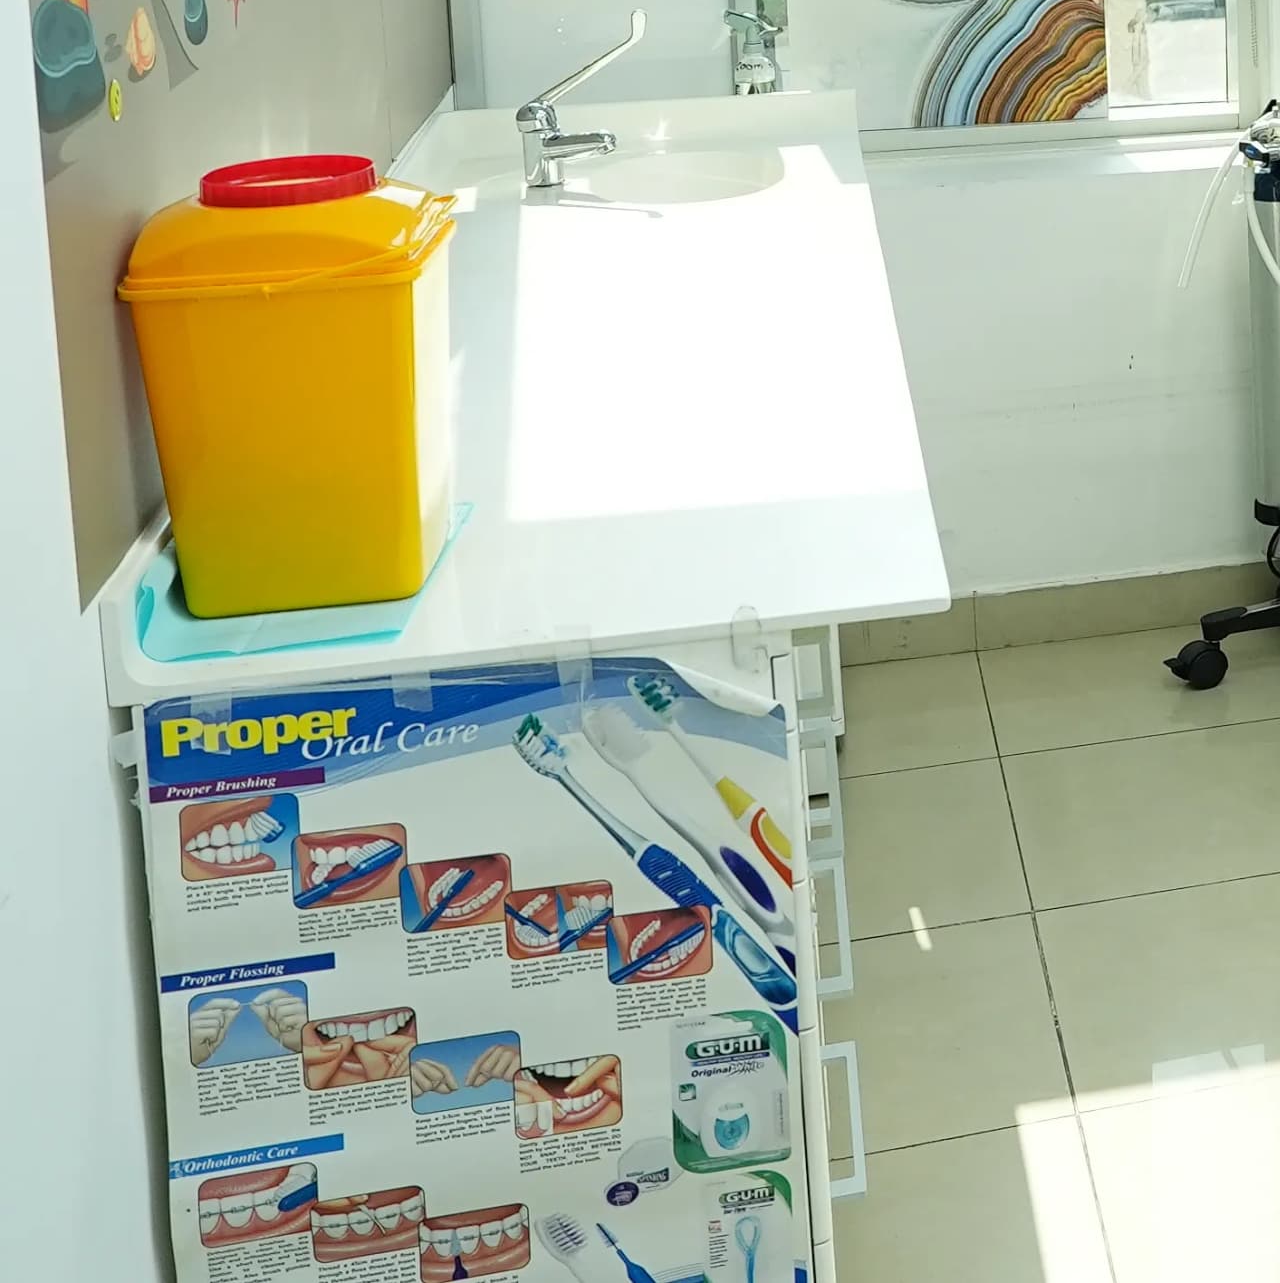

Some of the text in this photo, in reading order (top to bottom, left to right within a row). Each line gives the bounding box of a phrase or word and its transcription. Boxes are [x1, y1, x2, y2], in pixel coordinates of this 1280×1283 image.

[160, 707, 356, 757] Proper
[302, 722, 480, 760] Oral Care
[166, 776, 277, 798] Proper Brushing
[180, 964, 284, 988] Proper Flossing
[691, 1066, 731, 1078] Original
[183, 1145, 298, 1173] Orthodontic Care
